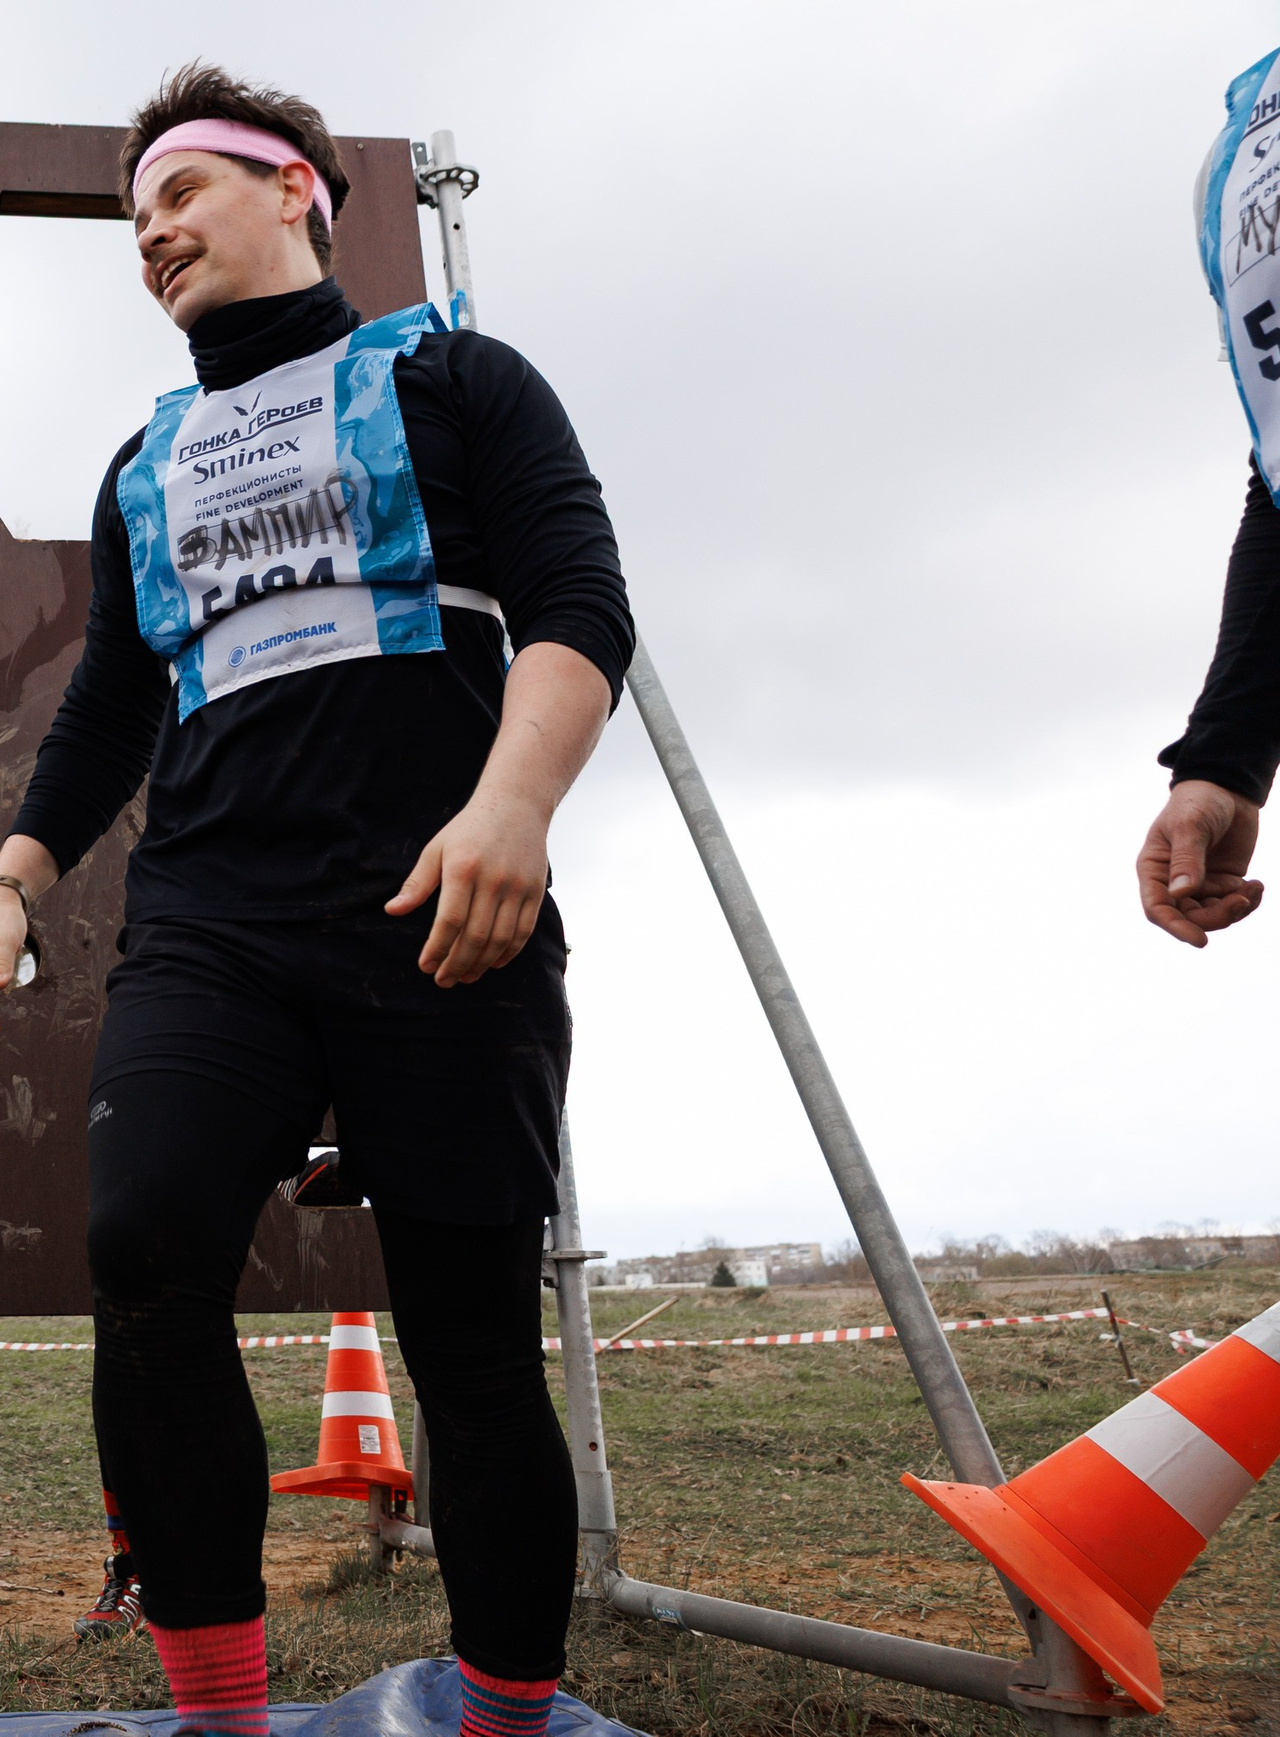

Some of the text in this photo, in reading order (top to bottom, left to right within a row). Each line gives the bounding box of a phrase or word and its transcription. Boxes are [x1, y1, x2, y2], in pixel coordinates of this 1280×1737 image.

[178, 396, 324, 461] ГОНКА ГЕРОЕВ
[193, 436, 301, 485] Sminex
[194, 464, 302, 508] ПЕРФЕКЦИОНИСТЫ
[195, 479, 305, 522] FINE DEVELOPMENT
[250, 622, 338, 656] ГАЗПРОМБАНК
